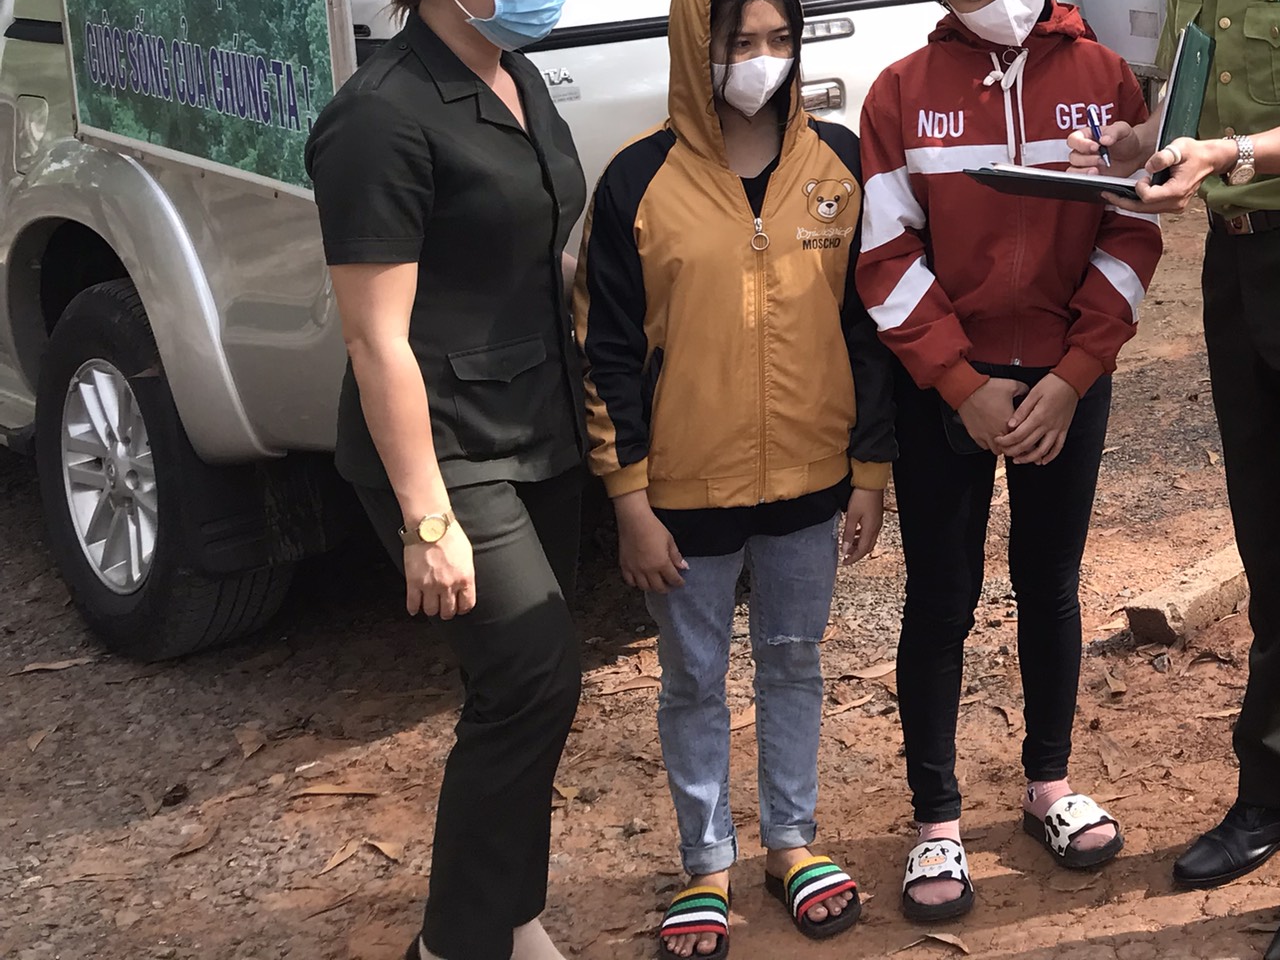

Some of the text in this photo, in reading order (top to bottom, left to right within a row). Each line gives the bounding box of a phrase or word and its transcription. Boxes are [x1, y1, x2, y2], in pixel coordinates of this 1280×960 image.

[85, 9, 127, 100] CUỘC
[126, 8, 173, 102] SỐNG
[172, 16, 210, 110] CỦA
[209, 33, 273, 127] CHÚNG
[270, 58, 301, 132] TA
[918, 109, 964, 138] NDU
